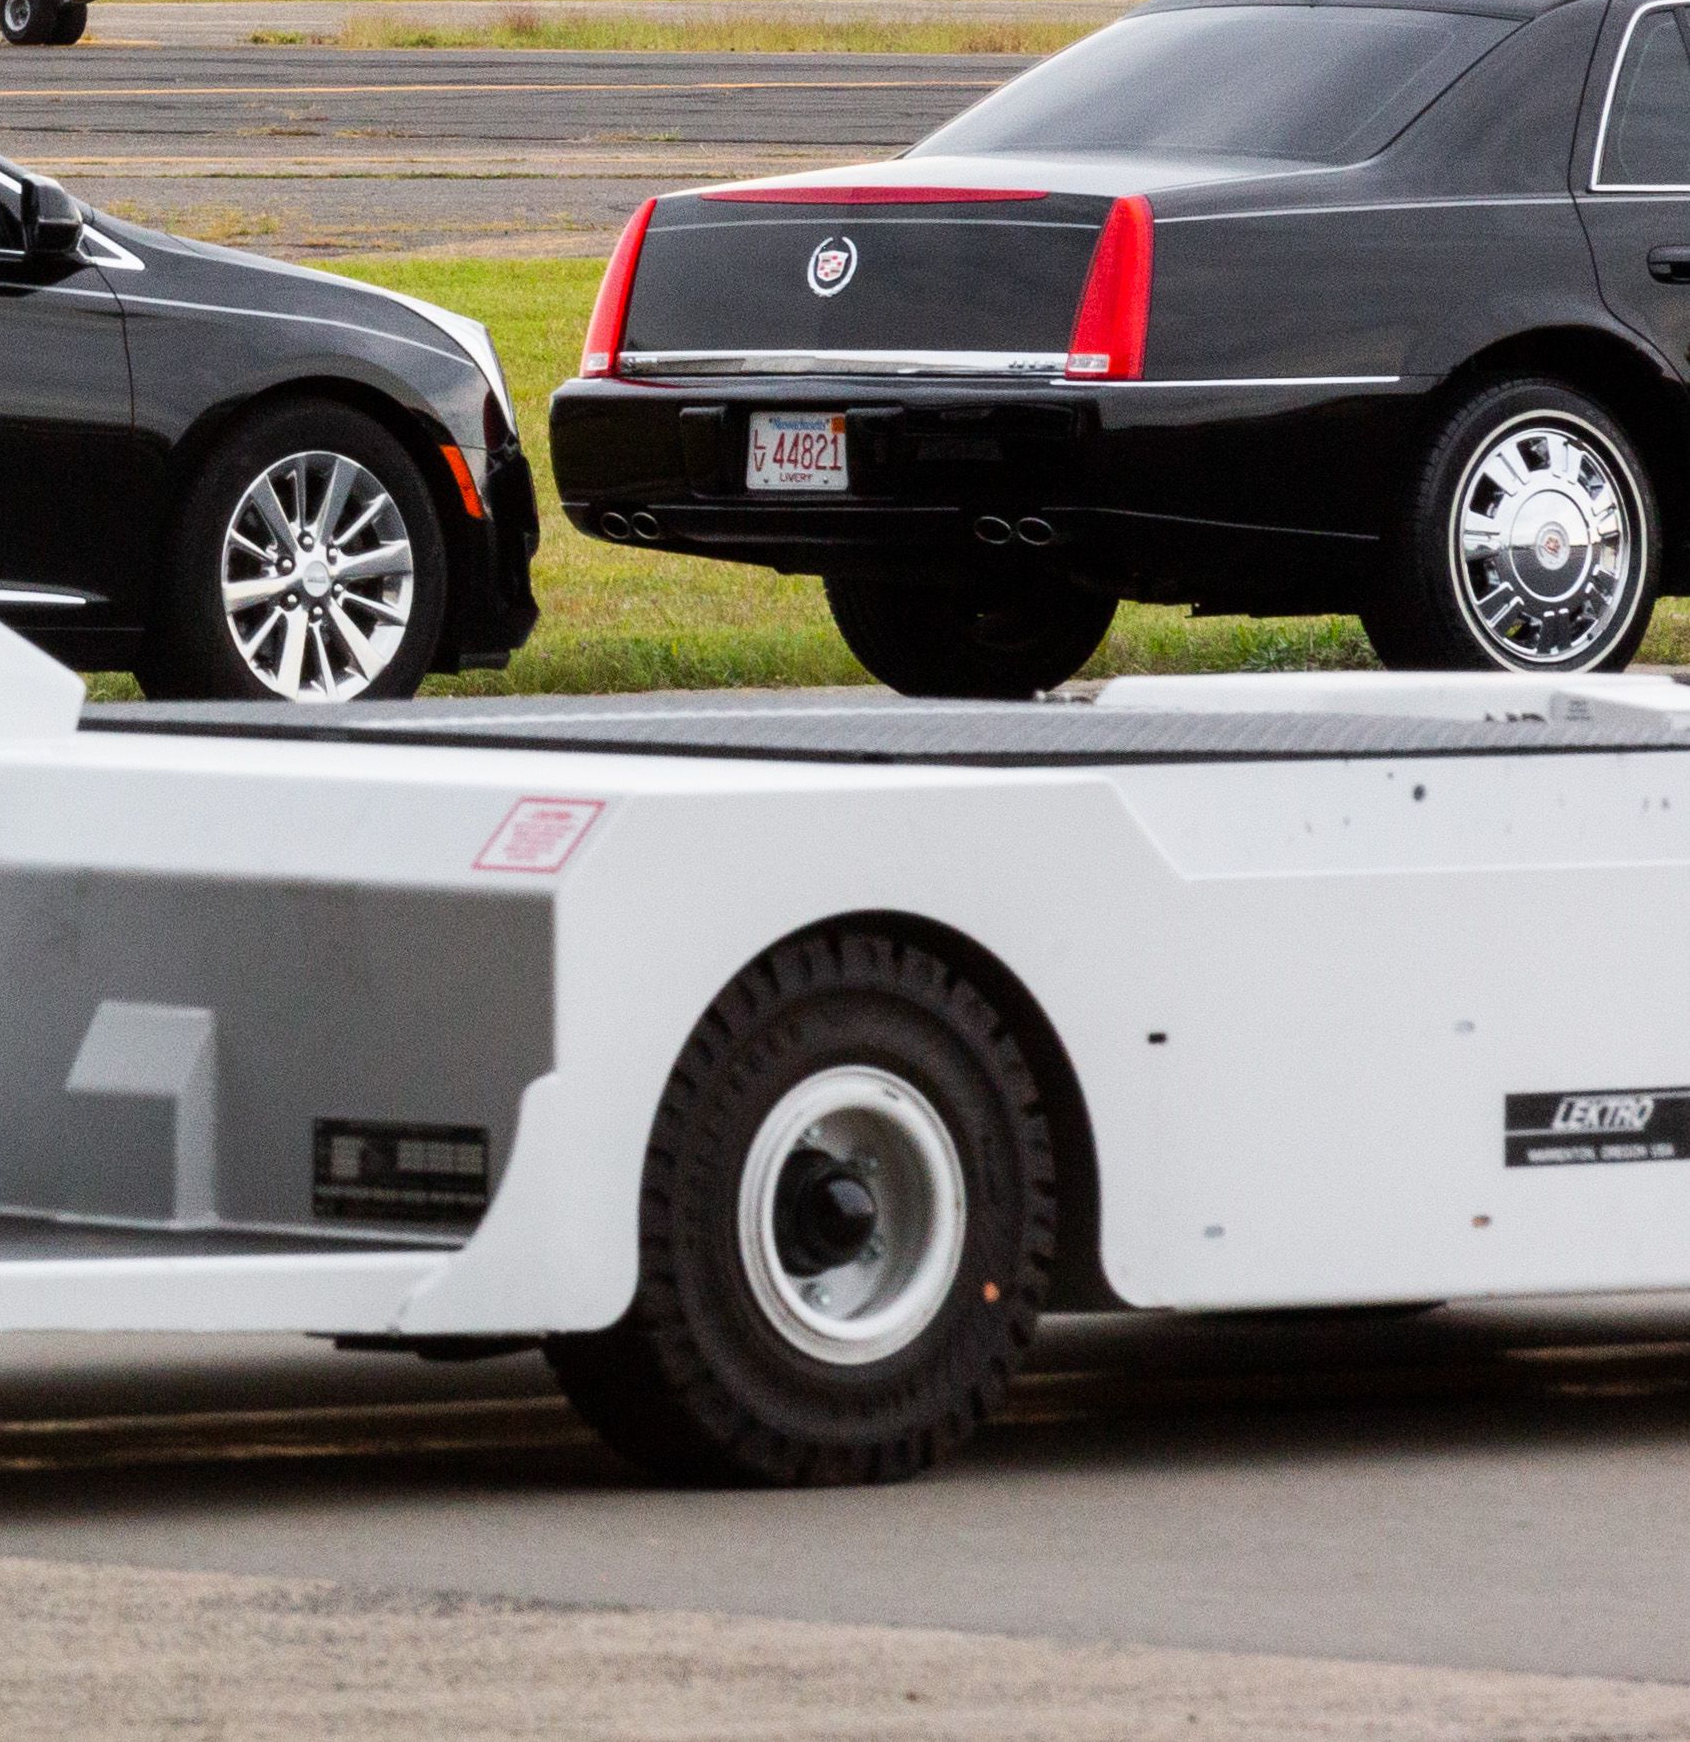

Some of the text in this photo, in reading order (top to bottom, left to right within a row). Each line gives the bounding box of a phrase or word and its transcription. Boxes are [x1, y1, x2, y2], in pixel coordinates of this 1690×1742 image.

[772, 432, 843, 470] 44821
[779, 472, 814, 483] LIVERY
[1550, 1093, 1656, 1133] LEKTRO
